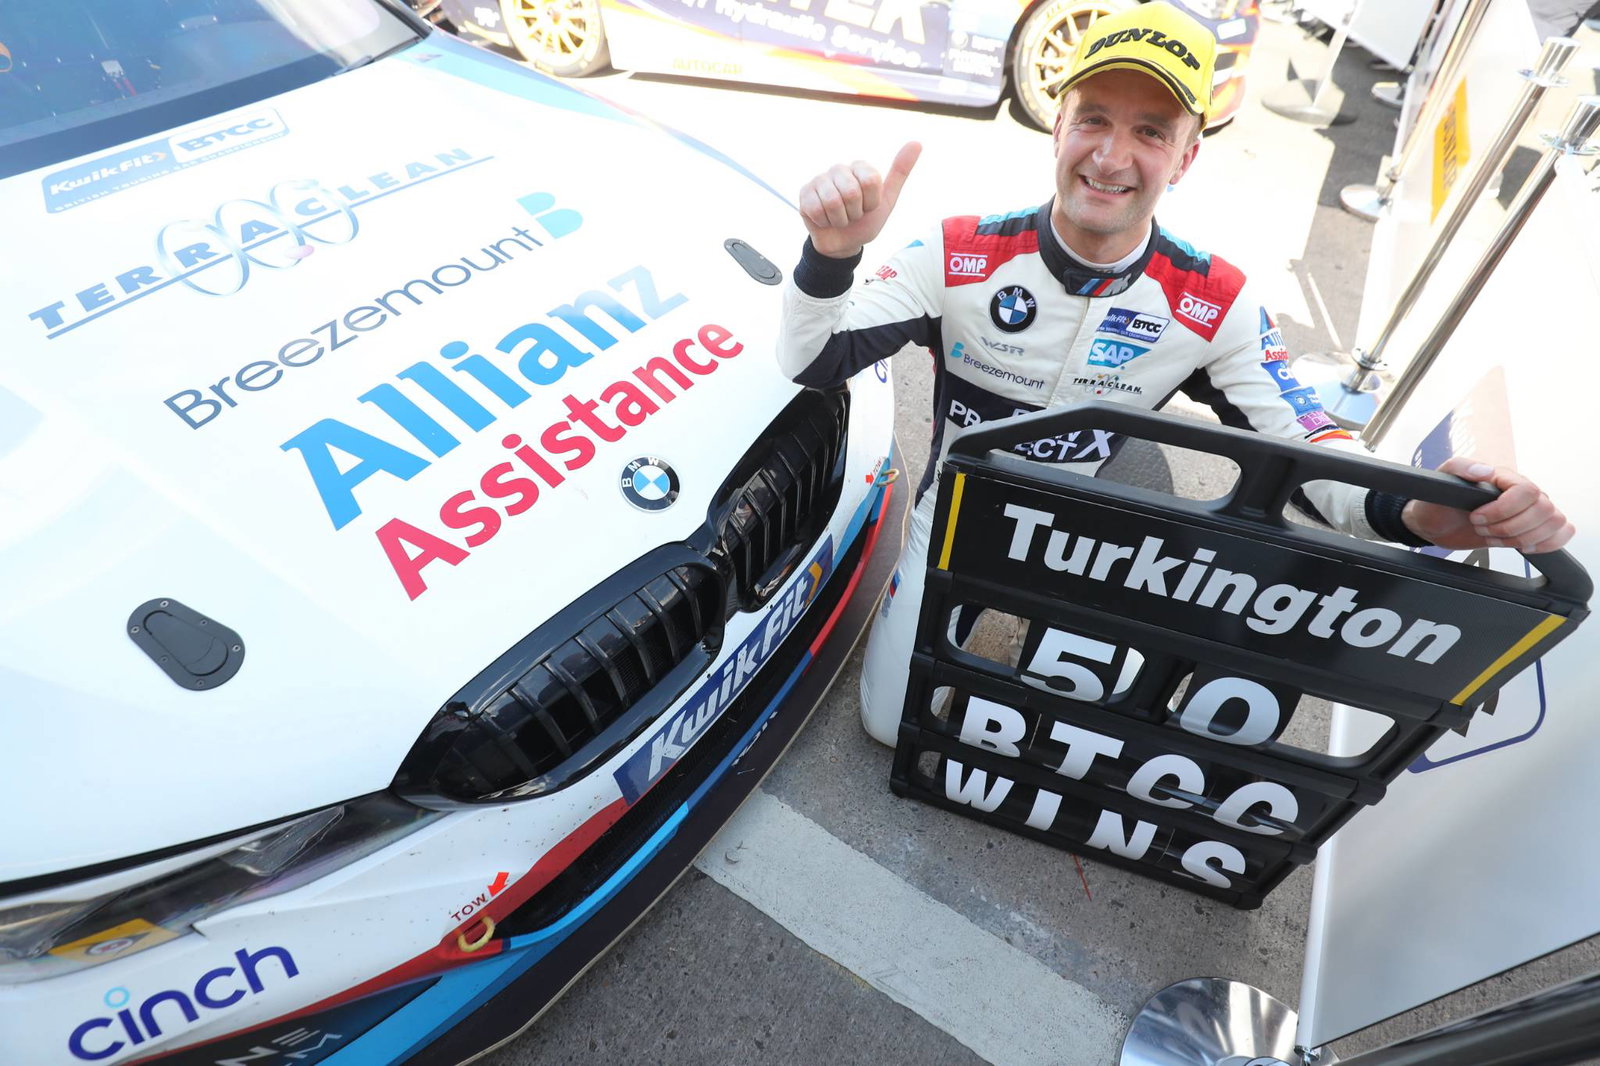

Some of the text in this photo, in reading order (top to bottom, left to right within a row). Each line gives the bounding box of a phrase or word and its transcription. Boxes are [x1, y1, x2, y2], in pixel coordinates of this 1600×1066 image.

[1084, 28, 1200, 70] DUNLOP
[177, 118, 273, 152] BTCC
[28, 148, 474, 330] TERRACLEAN
[950, 256, 987, 273] OMP
[163, 227, 545, 430] Breezemount
[1132, 318, 1162, 333] BTCC
[1180, 297, 1219, 322] OMP
[963, 353, 1045, 389] Breezemount
[1089, 342, 1134, 364] SAP
[279, 265, 688, 531] Allianz
[375, 323, 744, 601] Assistance
[1002, 505, 1462, 665] Turkington
[959, 695, 1299, 835] BTCC
[945, 758, 1246, 889] WINS
[451, 893, 487, 921] TOW
[68, 945, 299, 1061] cinch
